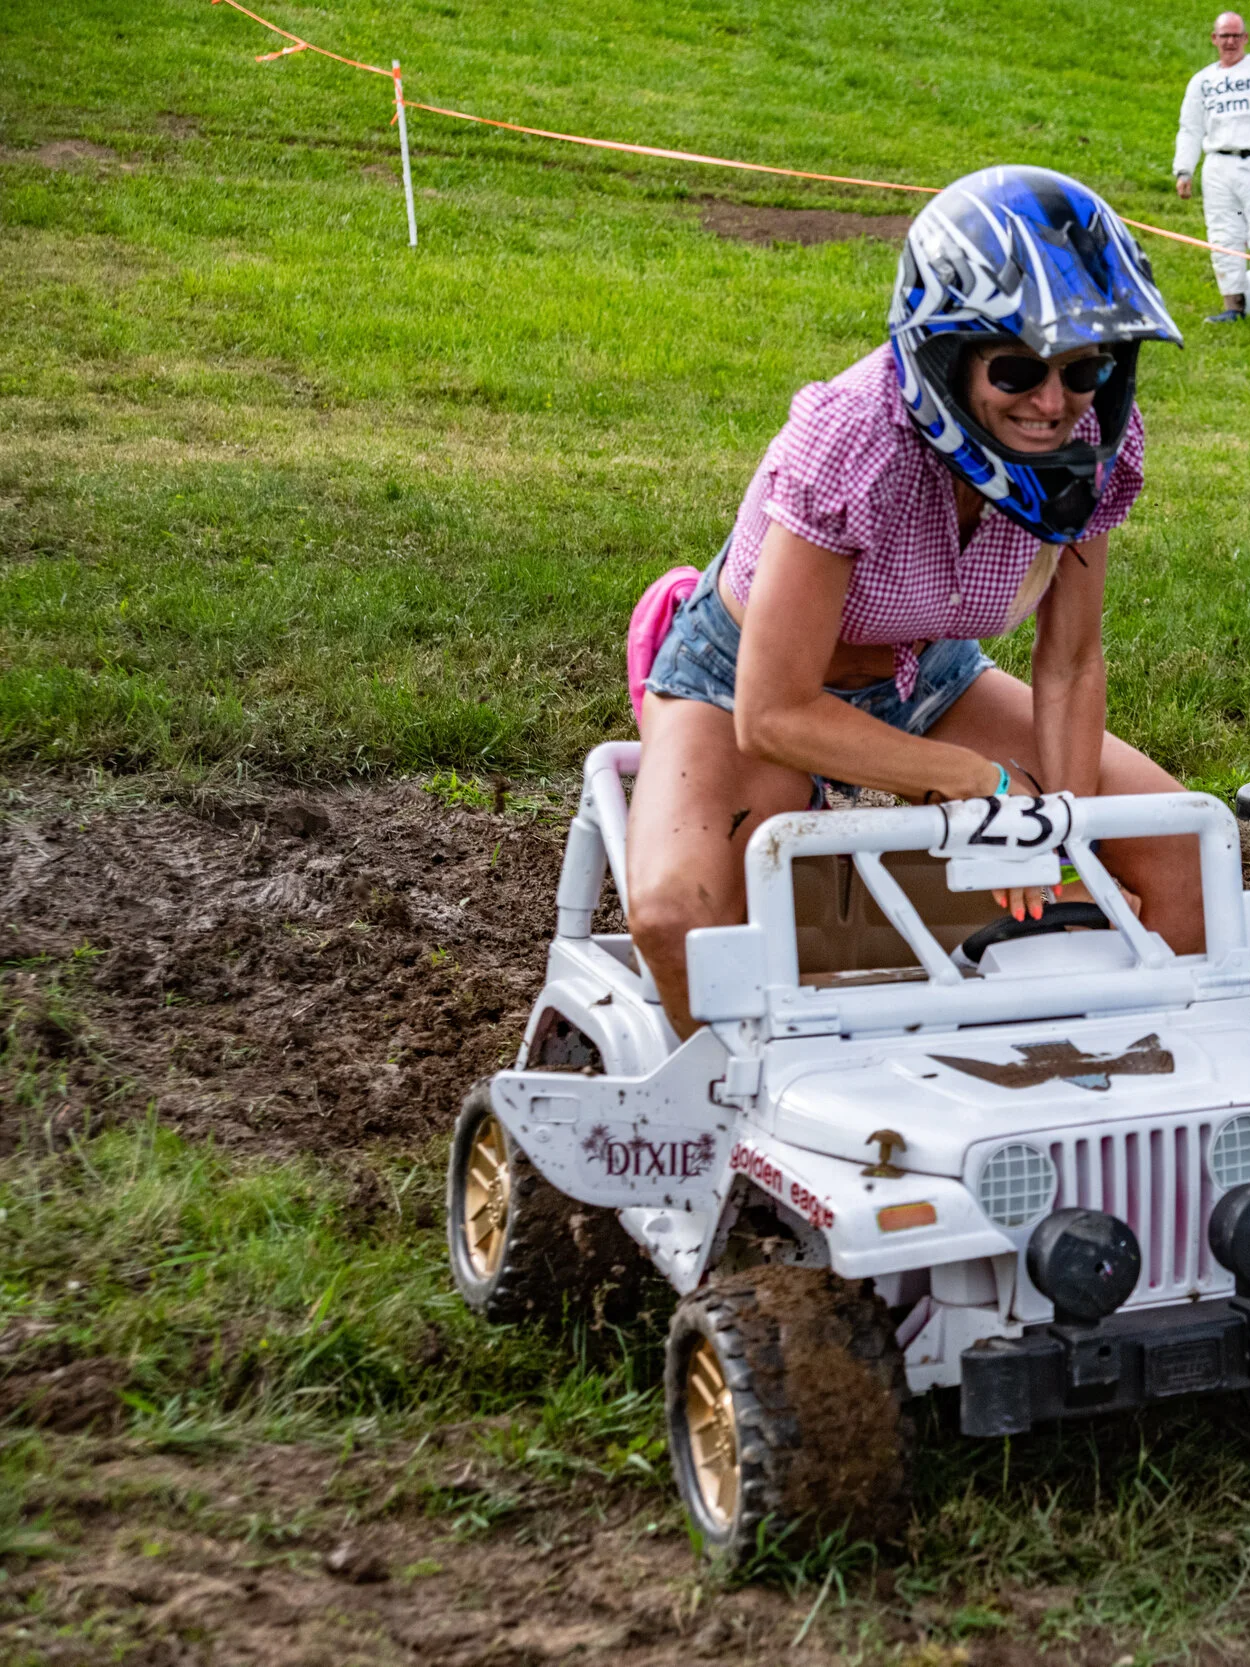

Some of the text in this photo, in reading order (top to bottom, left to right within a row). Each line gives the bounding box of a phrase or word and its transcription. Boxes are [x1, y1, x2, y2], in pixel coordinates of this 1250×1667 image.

[968, 794, 1053, 848] 23
[605, 1141, 701, 1177] DIXIE
[729, 1141, 783, 1194] golden
